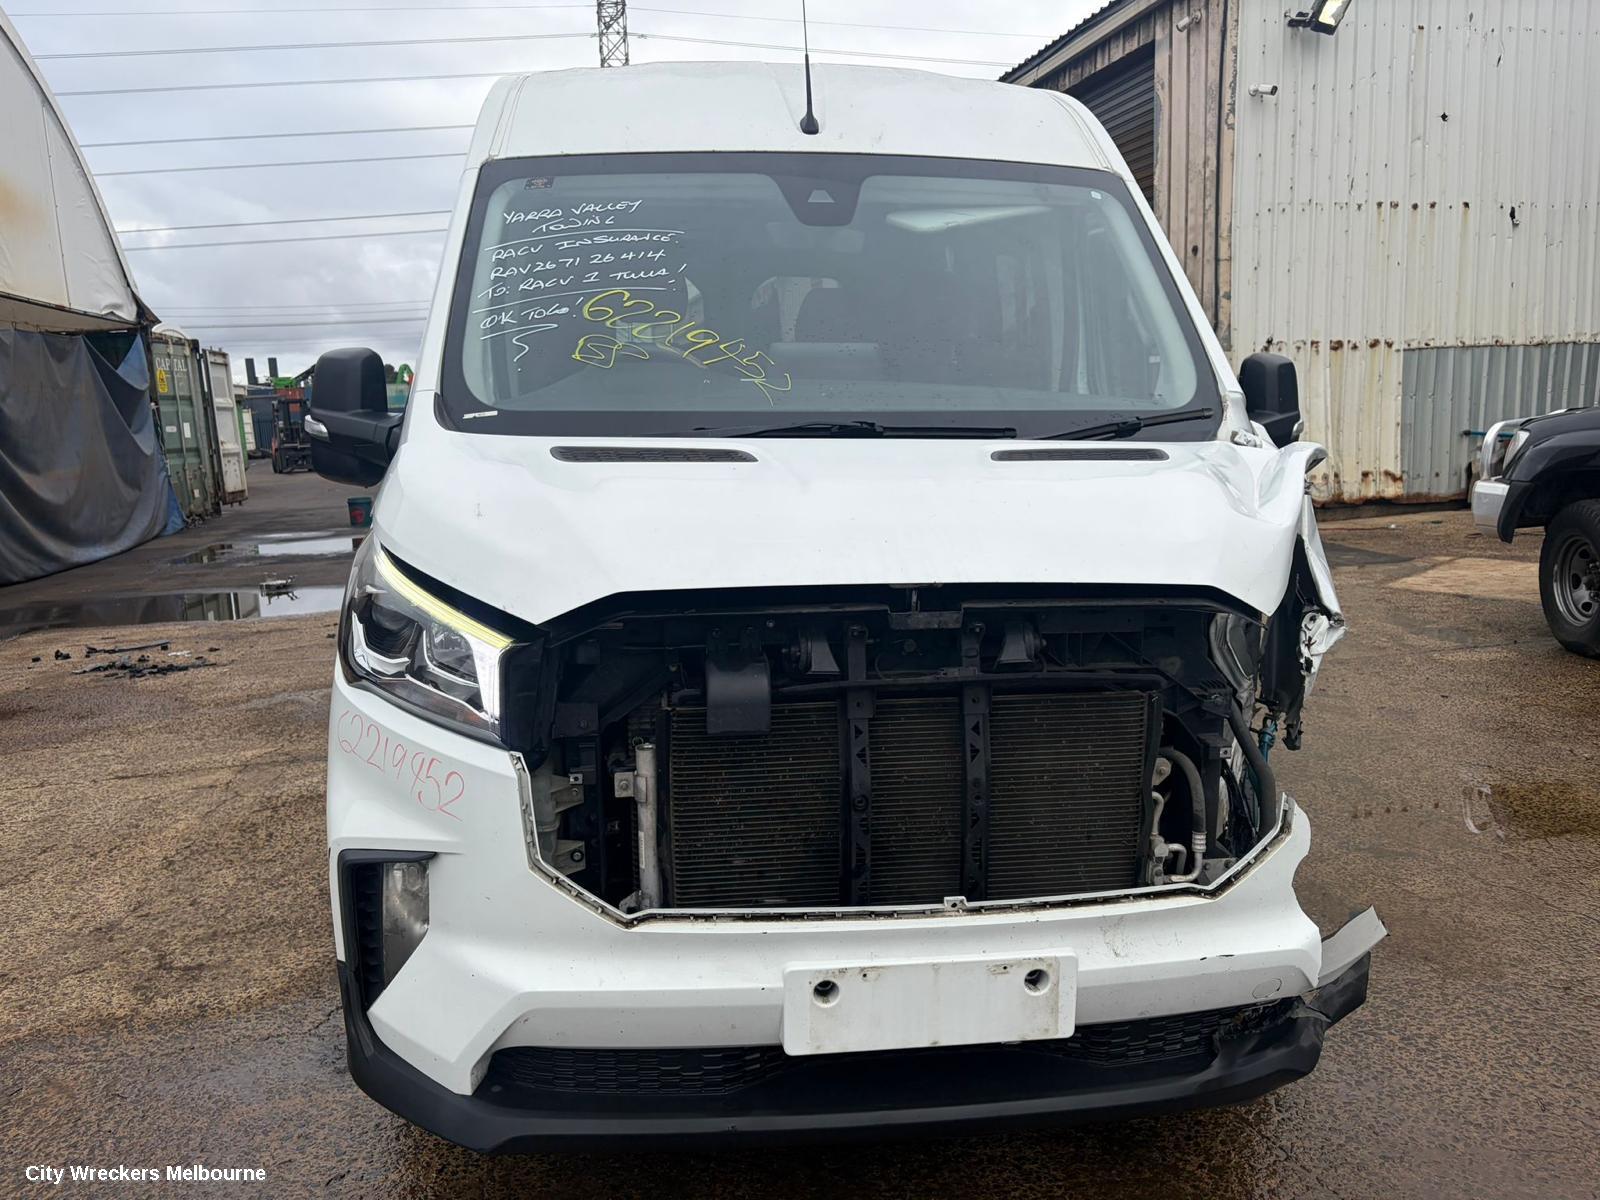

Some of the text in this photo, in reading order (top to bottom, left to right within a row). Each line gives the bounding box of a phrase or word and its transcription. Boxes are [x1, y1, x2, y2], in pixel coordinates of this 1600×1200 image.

[503, 199, 642, 224] YARRA VALLEY
[492, 244, 543, 262] RACV
[519, 276, 574, 291] RACV
[480, 310, 517, 329] OK
